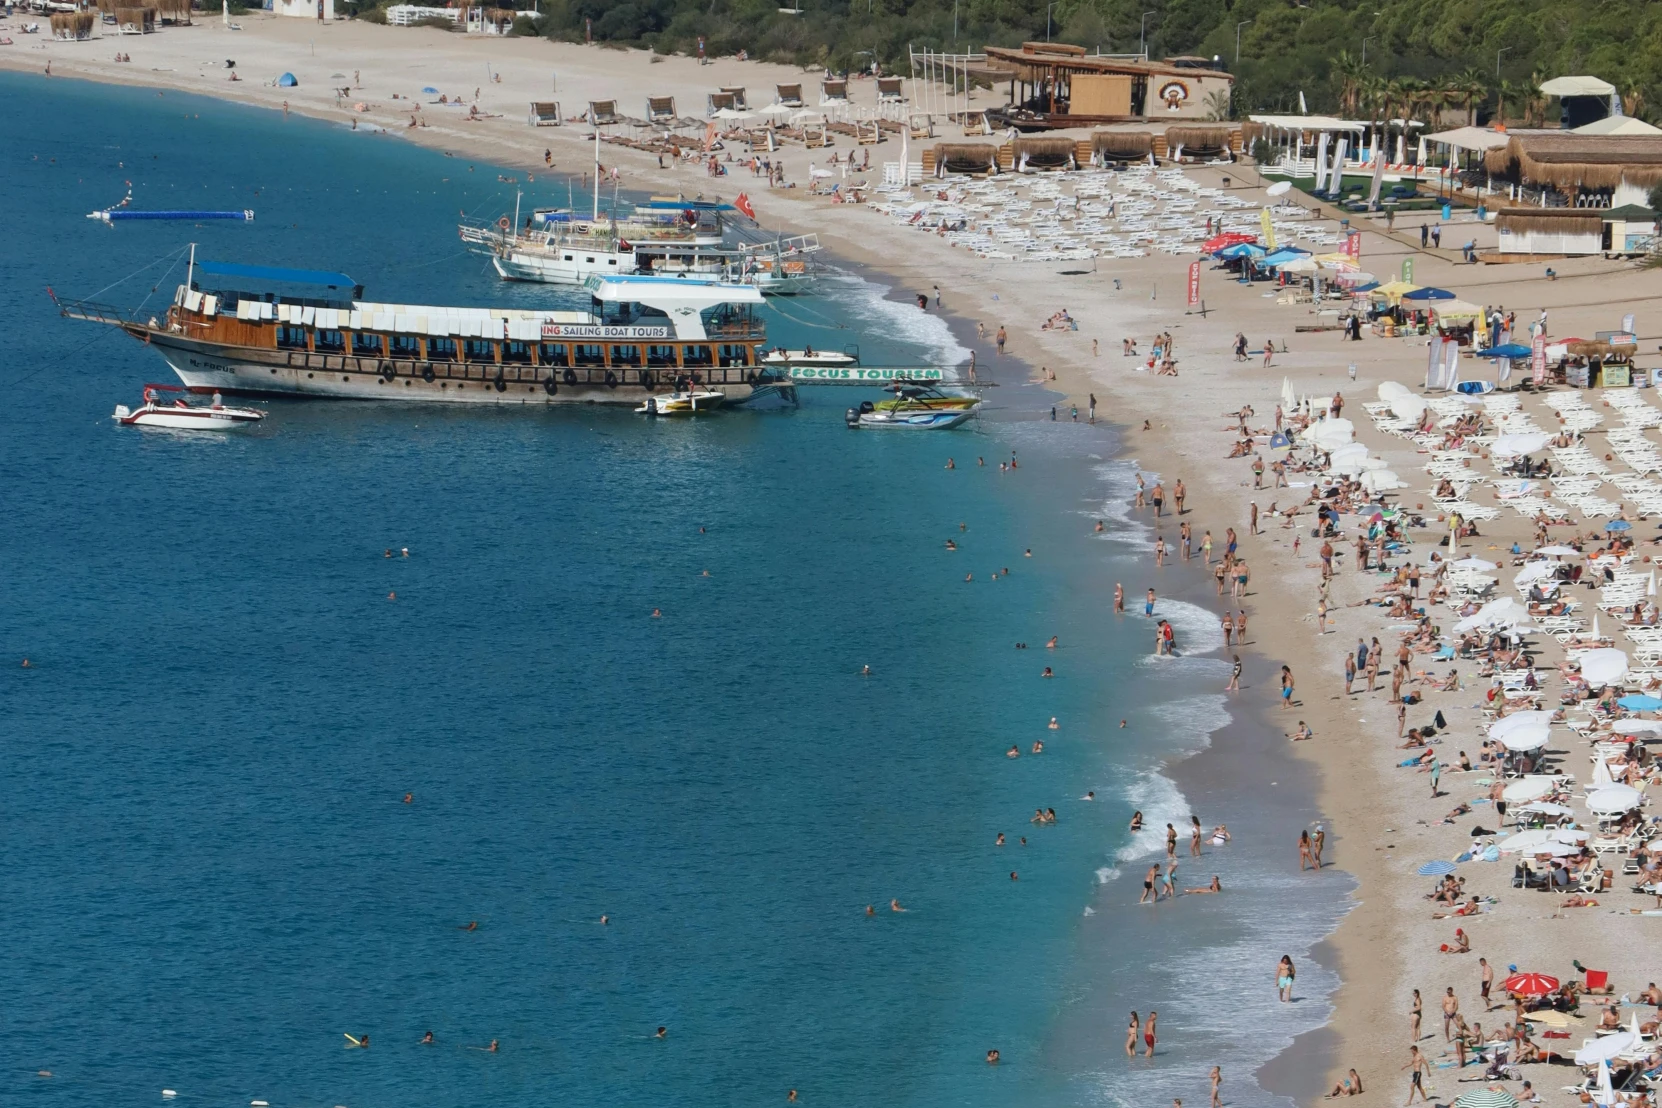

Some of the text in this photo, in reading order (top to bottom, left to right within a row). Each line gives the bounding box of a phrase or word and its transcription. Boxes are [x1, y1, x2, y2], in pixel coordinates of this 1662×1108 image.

[604, 327, 629, 337] BOAT
[632, 327, 665, 337] TOURS
[203, 362, 235, 374] FOCUS
[791, 366, 941, 379] FOCUS TOURISM
